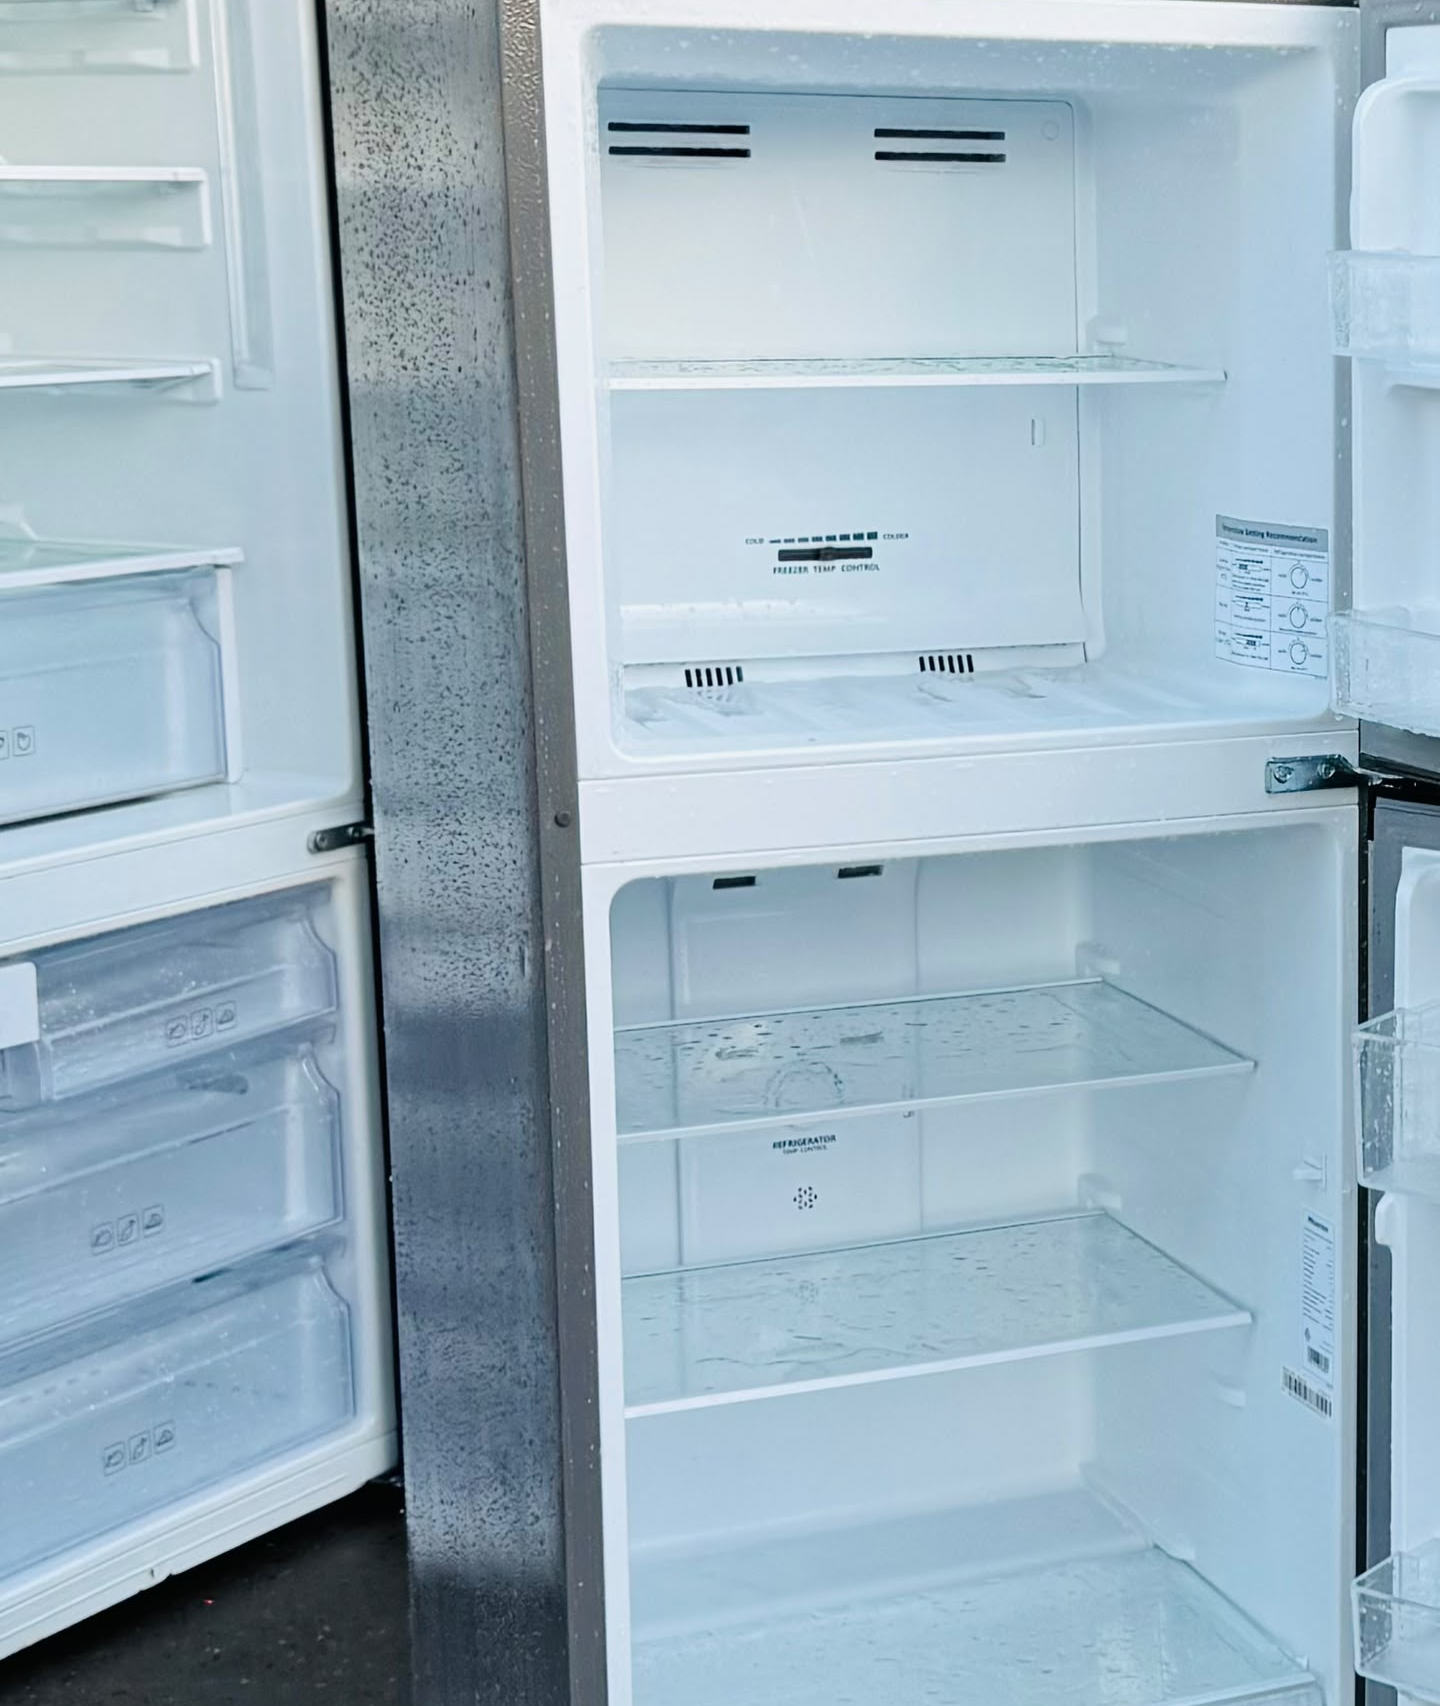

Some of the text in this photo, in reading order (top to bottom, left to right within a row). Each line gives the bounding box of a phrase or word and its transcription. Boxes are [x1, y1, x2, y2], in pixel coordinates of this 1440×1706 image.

[773, 564, 880, 574] FREEZER TEMP CONTROL
[773, 1134, 836, 1149] REFRIGERATOR
